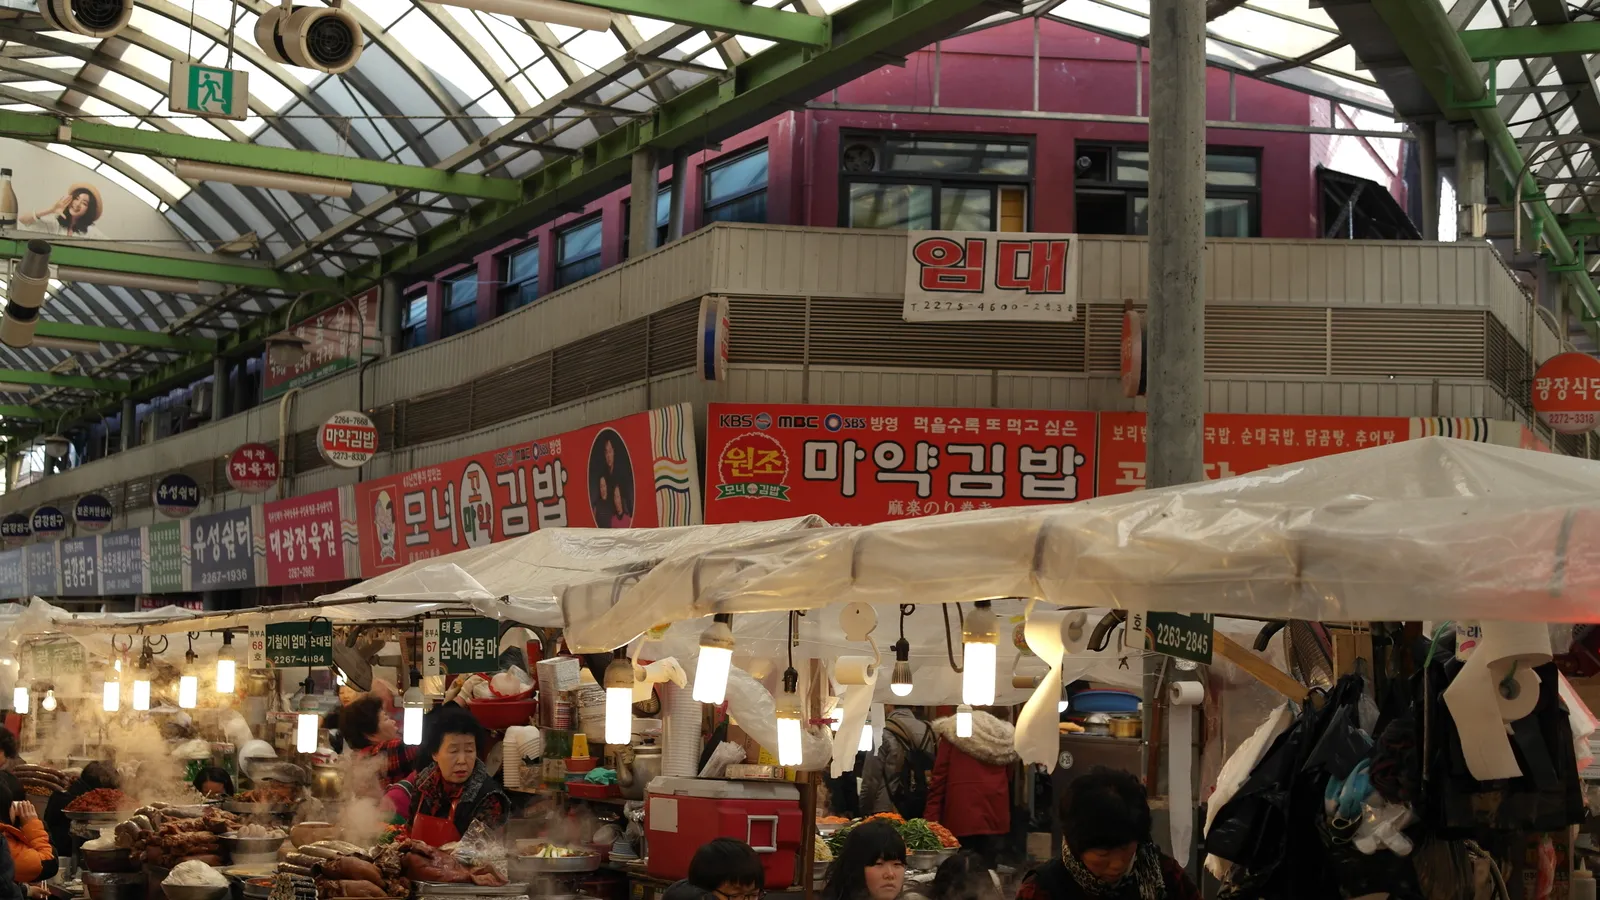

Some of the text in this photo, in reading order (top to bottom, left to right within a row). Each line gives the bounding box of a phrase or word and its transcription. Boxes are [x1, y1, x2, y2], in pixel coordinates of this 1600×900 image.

[912, 237, 1070, 295] 임대
[719, 414, 899, 432] KBS MBC SBS 방영
[913, 416, 1078, 437] 먹을수록 또 먹고 싶은
[326, 428, 376, 449] 마약김밥
[1355, 429, 1396, 448] 추어탕
[233, 461, 276, 477] 정육점
[724, 446, 785, 477] 원조
[803, 438, 1086, 500] 마약김밥
[158, 484, 197, 502] 유성쉼터
[725, 485, 745, 495] 모녀
[759, 484, 780, 496] 김밥
[403, 457, 568, 548] 모녀 김밥
[463, 501, 492, 542] 마약
[193, 516, 251, 564] 유성쉼터
[269, 519, 336, 563] 대광정육점
[201, 568, 248, 584] 2267-1936
[252, 641, 263, 650] 68
[267, 634, 290, 649] 기철이
[291, 634, 307, 649] 엄마
[426, 642, 437, 652] 67
[440, 636, 497, 660] 순대아줌마
[1157, 622, 1209, 655] 2263-2845
[254, 653, 262, 661] 호
[427, 656, 436, 666] 호
